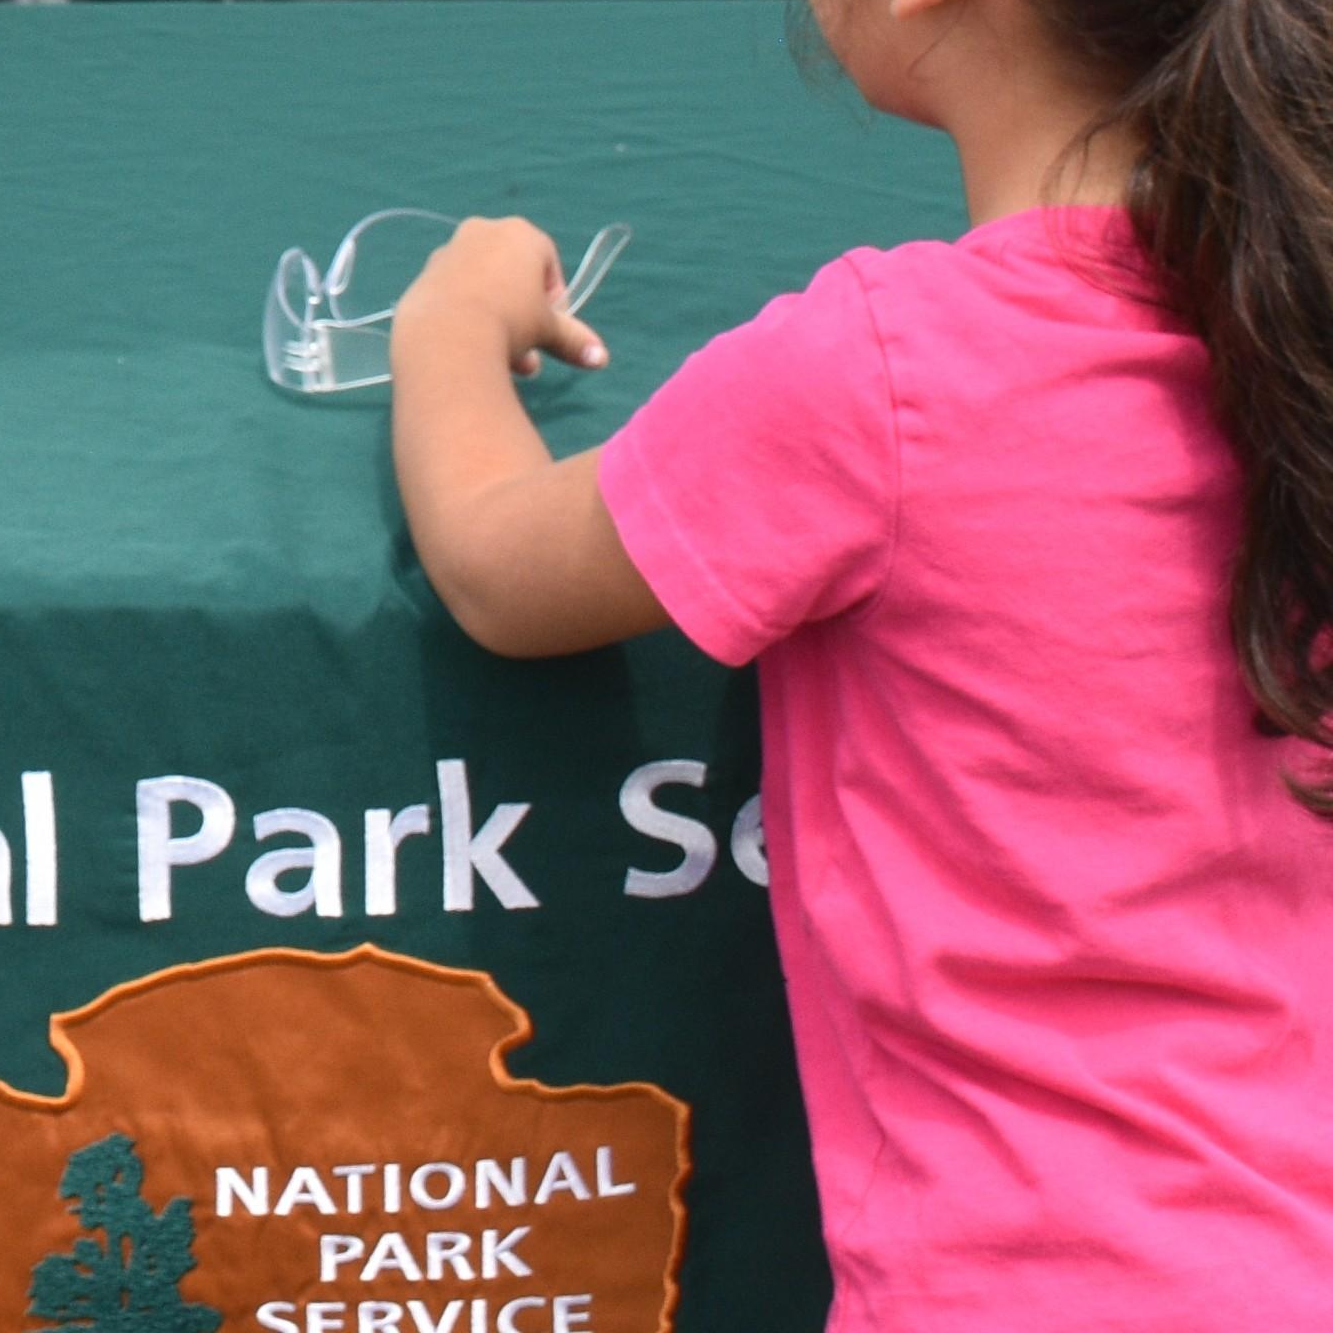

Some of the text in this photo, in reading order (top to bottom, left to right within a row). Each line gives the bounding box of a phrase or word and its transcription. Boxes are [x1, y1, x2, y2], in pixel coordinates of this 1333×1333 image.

[136, 759, 541, 923] Park
[215, 1145, 637, 1217] NATIONAL
[319, 1226, 533, 1283] PARK
[255, 1293, 593, 1333] SERVICE
